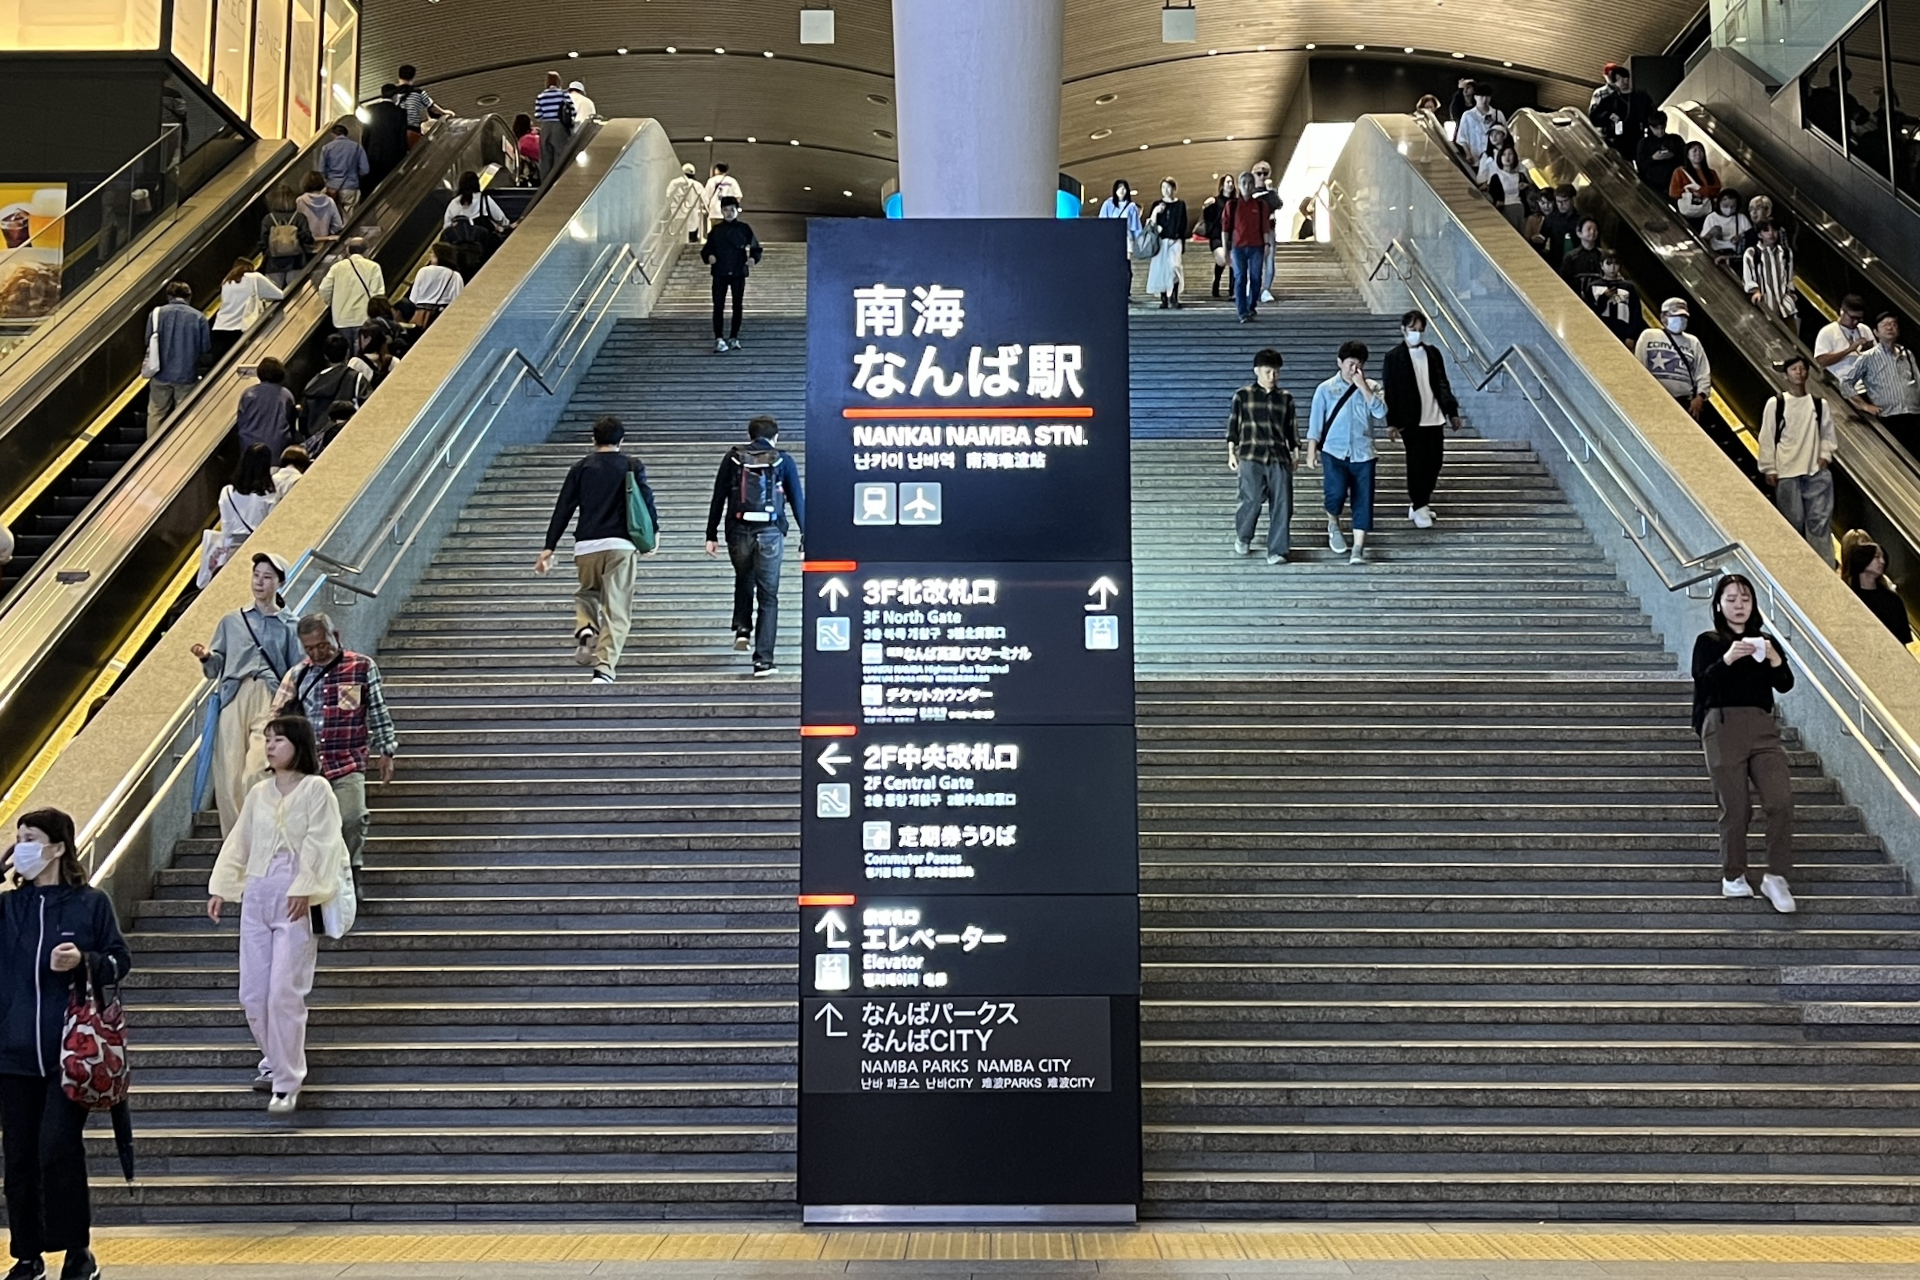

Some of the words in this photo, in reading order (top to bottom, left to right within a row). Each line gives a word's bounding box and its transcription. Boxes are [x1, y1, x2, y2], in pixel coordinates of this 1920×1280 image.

[853, 283, 965, 339] 南海
[1647, 341, 1695, 355] CONVRSE
[852, 344, 1084, 399] なんば駅
[853, 425, 942, 447] NANKAI
[945, 425, 1032, 447] NAMBA
[1034, 425, 1089, 447] STN.
[853, 451, 904, 471] 난카이
[907, 451, 956, 471] 난바역
[862, 577, 998, 606] 3F北改札口
[863, 610, 880, 625] 3F
[883, 610, 925, 625] North
[927, 610, 962, 625] Gate
[886, 687, 994, 703] チケットカウンター
[863, 743, 1020, 770] 2F中央改札口
[864, 775, 882, 790] 2F
[884, 775, 937, 790] Central
[939, 775, 974, 790] Gate
[898, 825, 1017, 848] 定期券うりば
[864, 853, 924, 865] Commuter
[926, 852, 962, 865] Passes
[862, 925, 1006, 952] エレベーター
[863, 953, 925, 969] Elevator
[861, 1001, 1019, 1026] なんばパークス
[861, 1029, 993, 1053] なんばCITY
[861, 1059, 918, 1074] NAMBA
[922, 1059, 969, 1074] PARKS
[977, 1059, 1034, 1074] NAMBA
[1038, 1059, 1071, 1073] CITY
[861, 1077, 884, 1090] 난바
[886, 1077, 920, 1090] 파크스
[926, 1077, 974, 1090] 난바CITY
